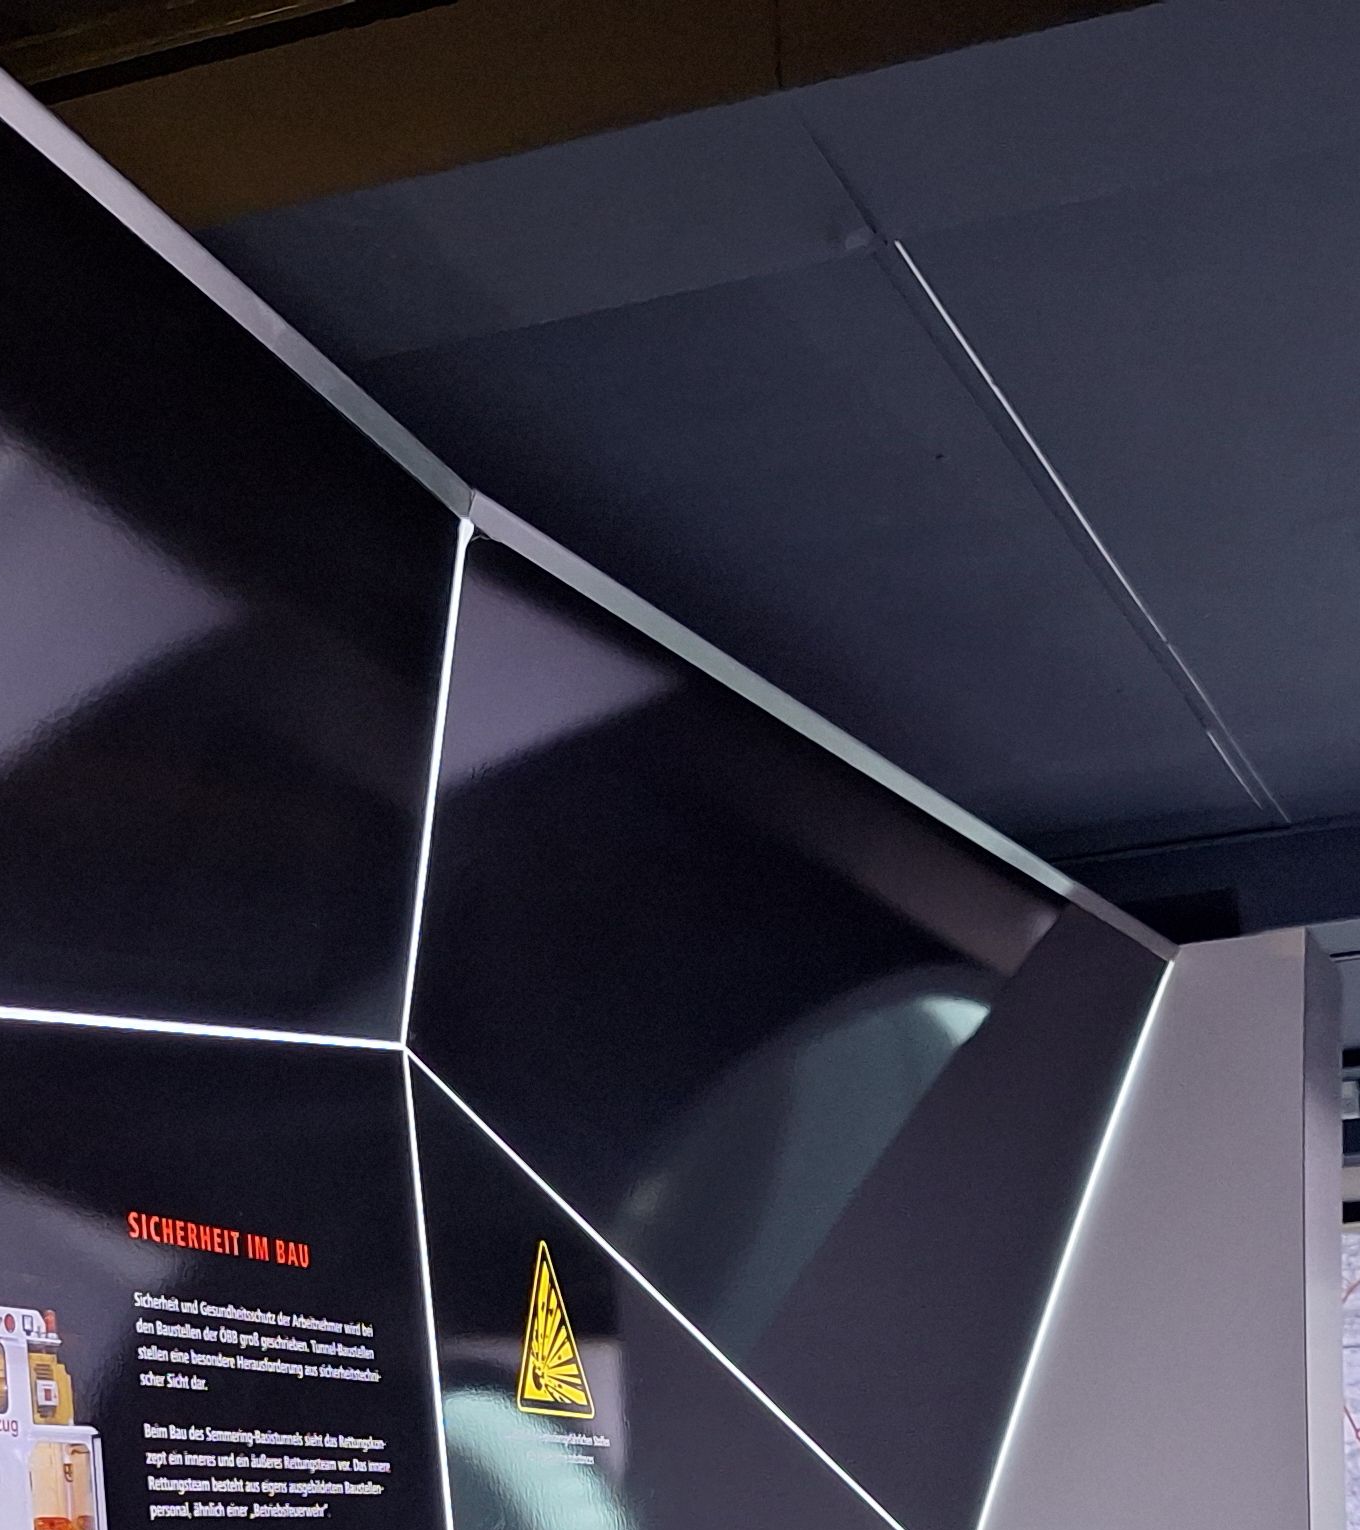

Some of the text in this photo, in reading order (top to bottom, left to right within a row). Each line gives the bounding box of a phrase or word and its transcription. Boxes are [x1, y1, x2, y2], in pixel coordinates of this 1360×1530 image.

[127, 1211, 309, 1268] SICHERHEIT IM BAU
[133, 1291, 180, 1313] Sicherheit
[180, 1299, 199, 1315] und
[276, 1311, 291, 1327] der
[343, 1322, 362, 1336] wird
[361, 1322, 374, 1338] bei
[135, 1317, 155, 1335] den
[155, 1320, 202, 1340] Baustellen
[202, 1326, 219, 1342] der
[239, 1331, 260, 1349] groß
[139, 1370, 209, 1391] scher Sicht dar.
